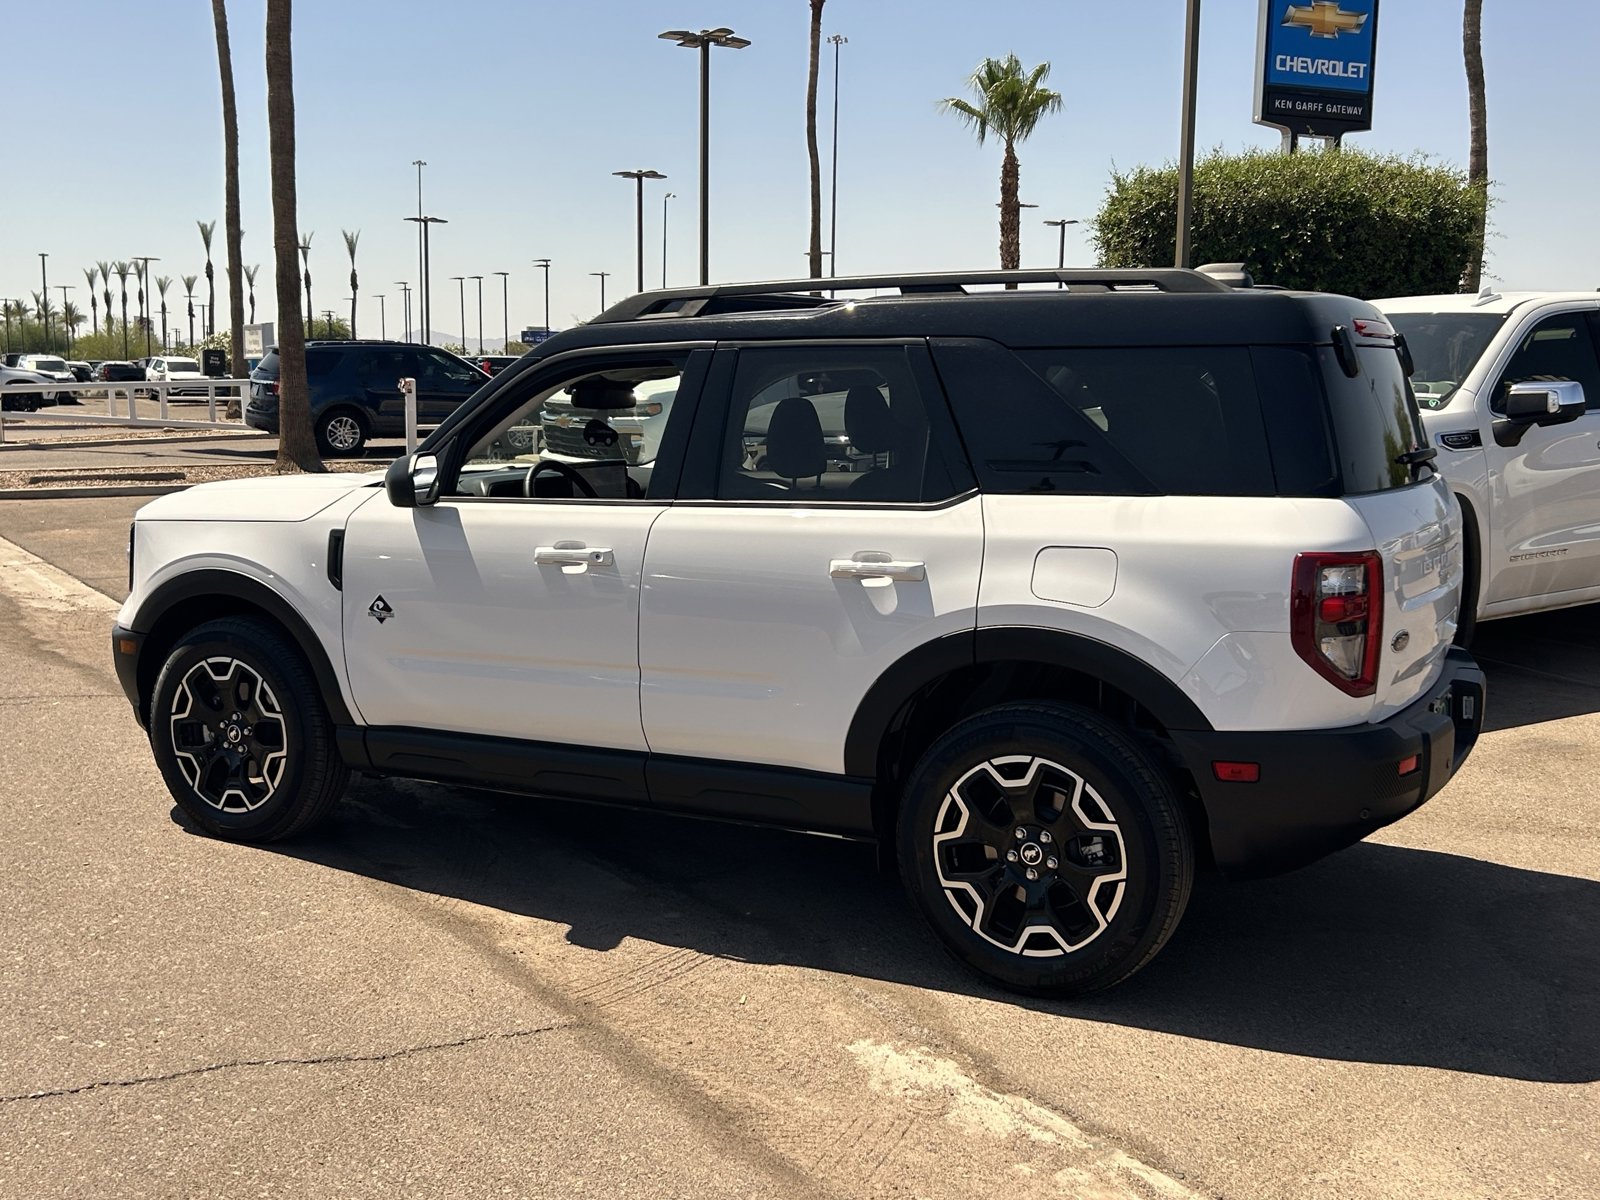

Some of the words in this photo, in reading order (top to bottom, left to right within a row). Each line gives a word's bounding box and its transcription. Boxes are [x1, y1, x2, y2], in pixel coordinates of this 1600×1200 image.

[1275, 54, 1367, 78] CHEVROLET
[1275, 99, 1293, 110] KEN
[1295, 101, 1323, 112] GARFF
[1326, 104, 1363, 116] GATEWAY
